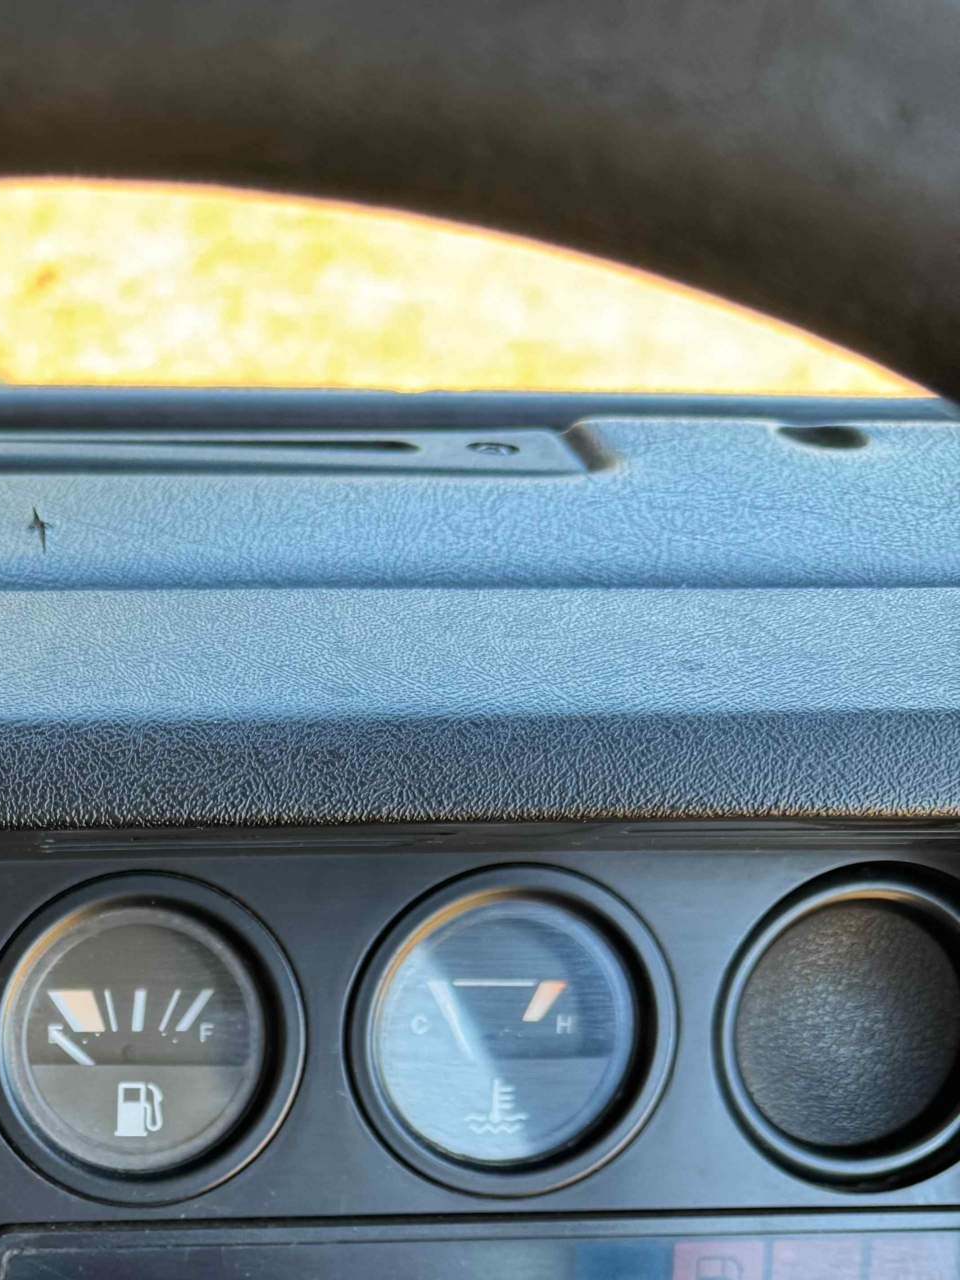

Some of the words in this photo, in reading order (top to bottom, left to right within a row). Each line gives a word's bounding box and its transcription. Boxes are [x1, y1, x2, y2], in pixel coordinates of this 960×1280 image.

[200, 1023, 214, 1042] F
[410, 1015, 427, 1034] C
[556, 1014, 573, 1034] H
